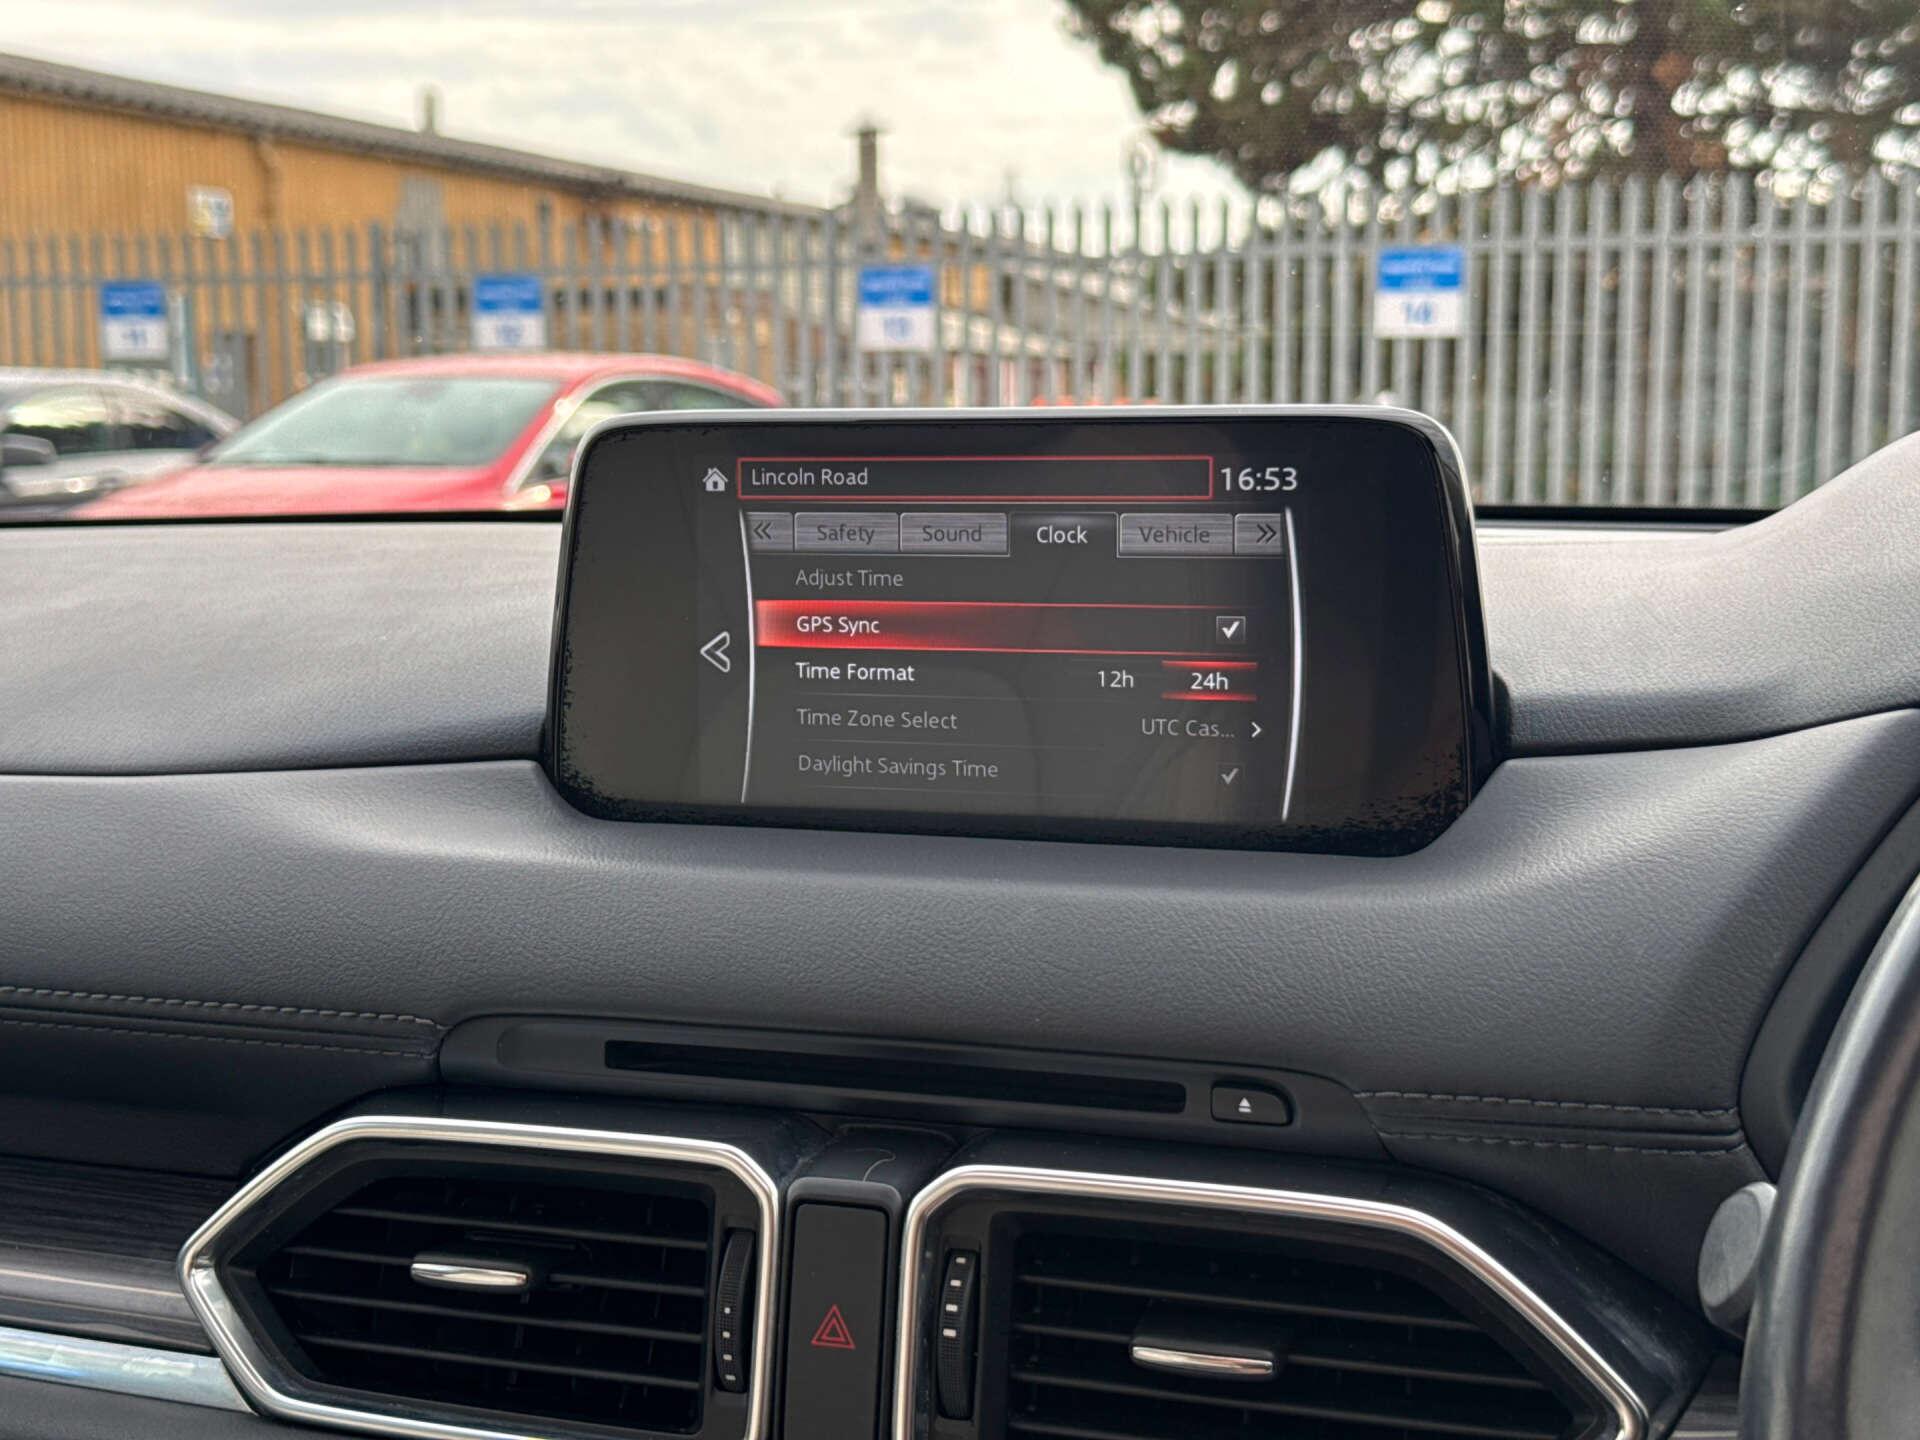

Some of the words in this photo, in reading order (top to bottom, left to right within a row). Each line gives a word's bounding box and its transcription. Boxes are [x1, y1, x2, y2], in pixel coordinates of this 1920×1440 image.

[751, 467, 815, 487] Lincoln
[822, 468, 869, 487] Road
[1221, 467, 1298, 491] 16:53
[816, 523, 875, 545] Safety
[922, 524, 982, 543] Sound
[1036, 525, 1088, 544] Clock
[1138, 526, 1211, 544] Vehicle
[795, 568, 853, 590] Adjust
[857, 569, 904, 587] Time
[796, 615, 833, 633] GPS
[838, 615, 880, 636] Sync
[795, 661, 841, 680] Time
[846, 663, 915, 682] Format
[1098, 670, 1135, 688] 12h
[1191, 672, 1229, 690] 24h
[797, 708, 842, 727] Time
[846, 710, 895, 728] Zone
[901, 711, 957, 730] Select
[1141, 718, 1179, 736] UTC
[798, 755, 872, 777] Daylight
[878, 757, 947, 779] Savings
[952, 760, 999, 778] Time
